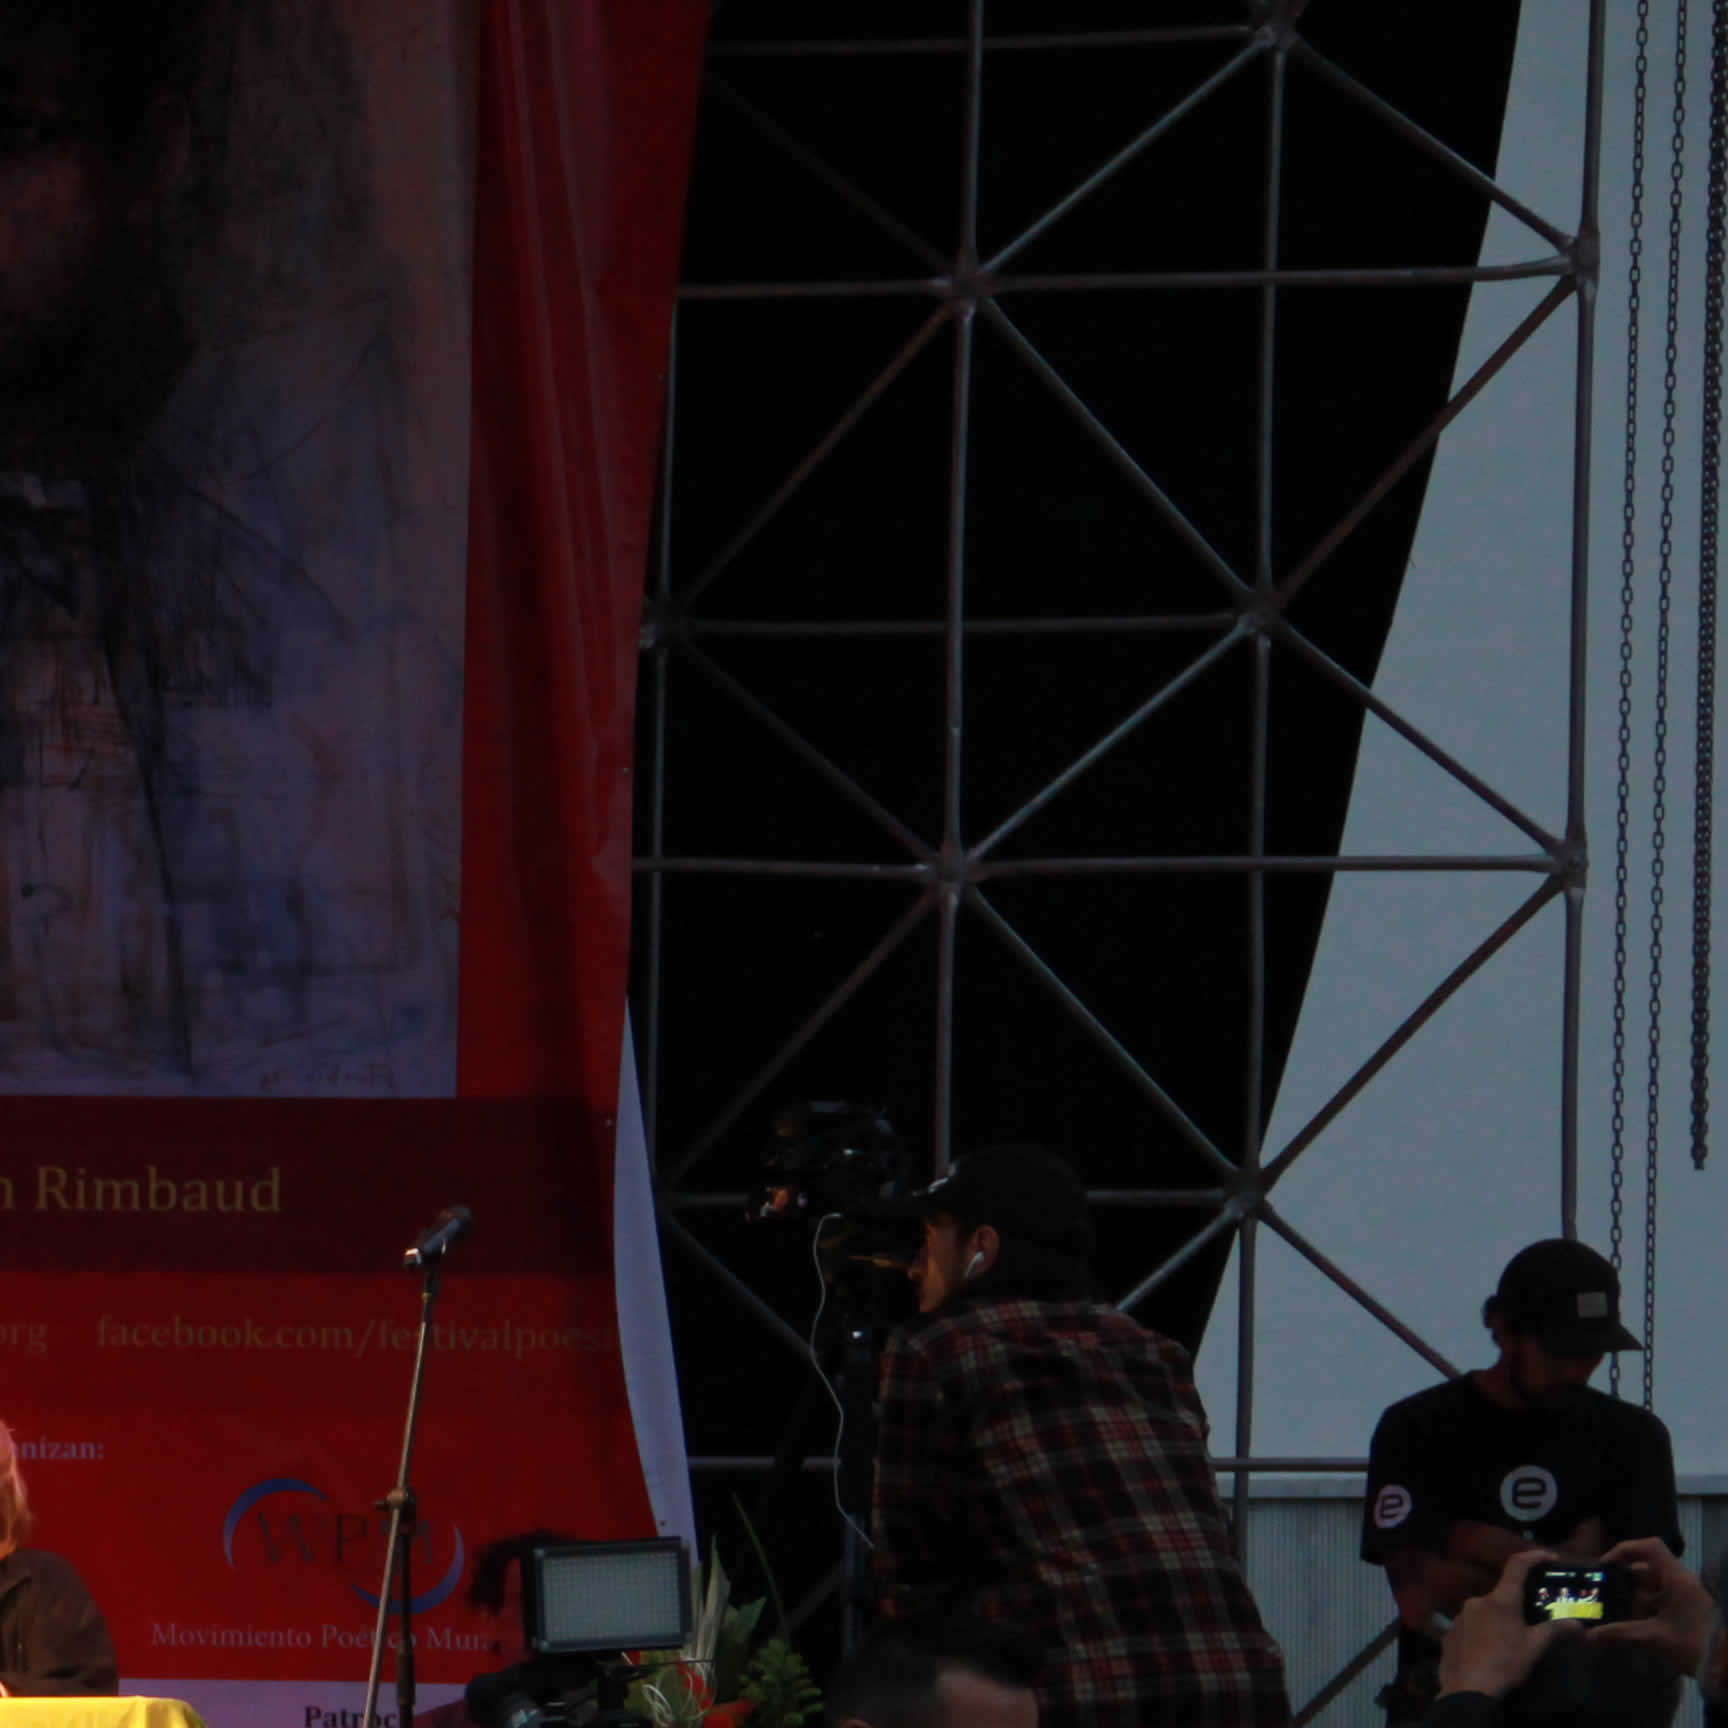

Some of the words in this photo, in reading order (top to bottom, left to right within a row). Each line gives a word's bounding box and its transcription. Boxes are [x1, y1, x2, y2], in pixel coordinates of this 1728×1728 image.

[34, 1165, 281, 1213] Rimbaud
[14, 1434, 104, 1460] nizan:
[152, 1622, 311, 1649] Movimiento
